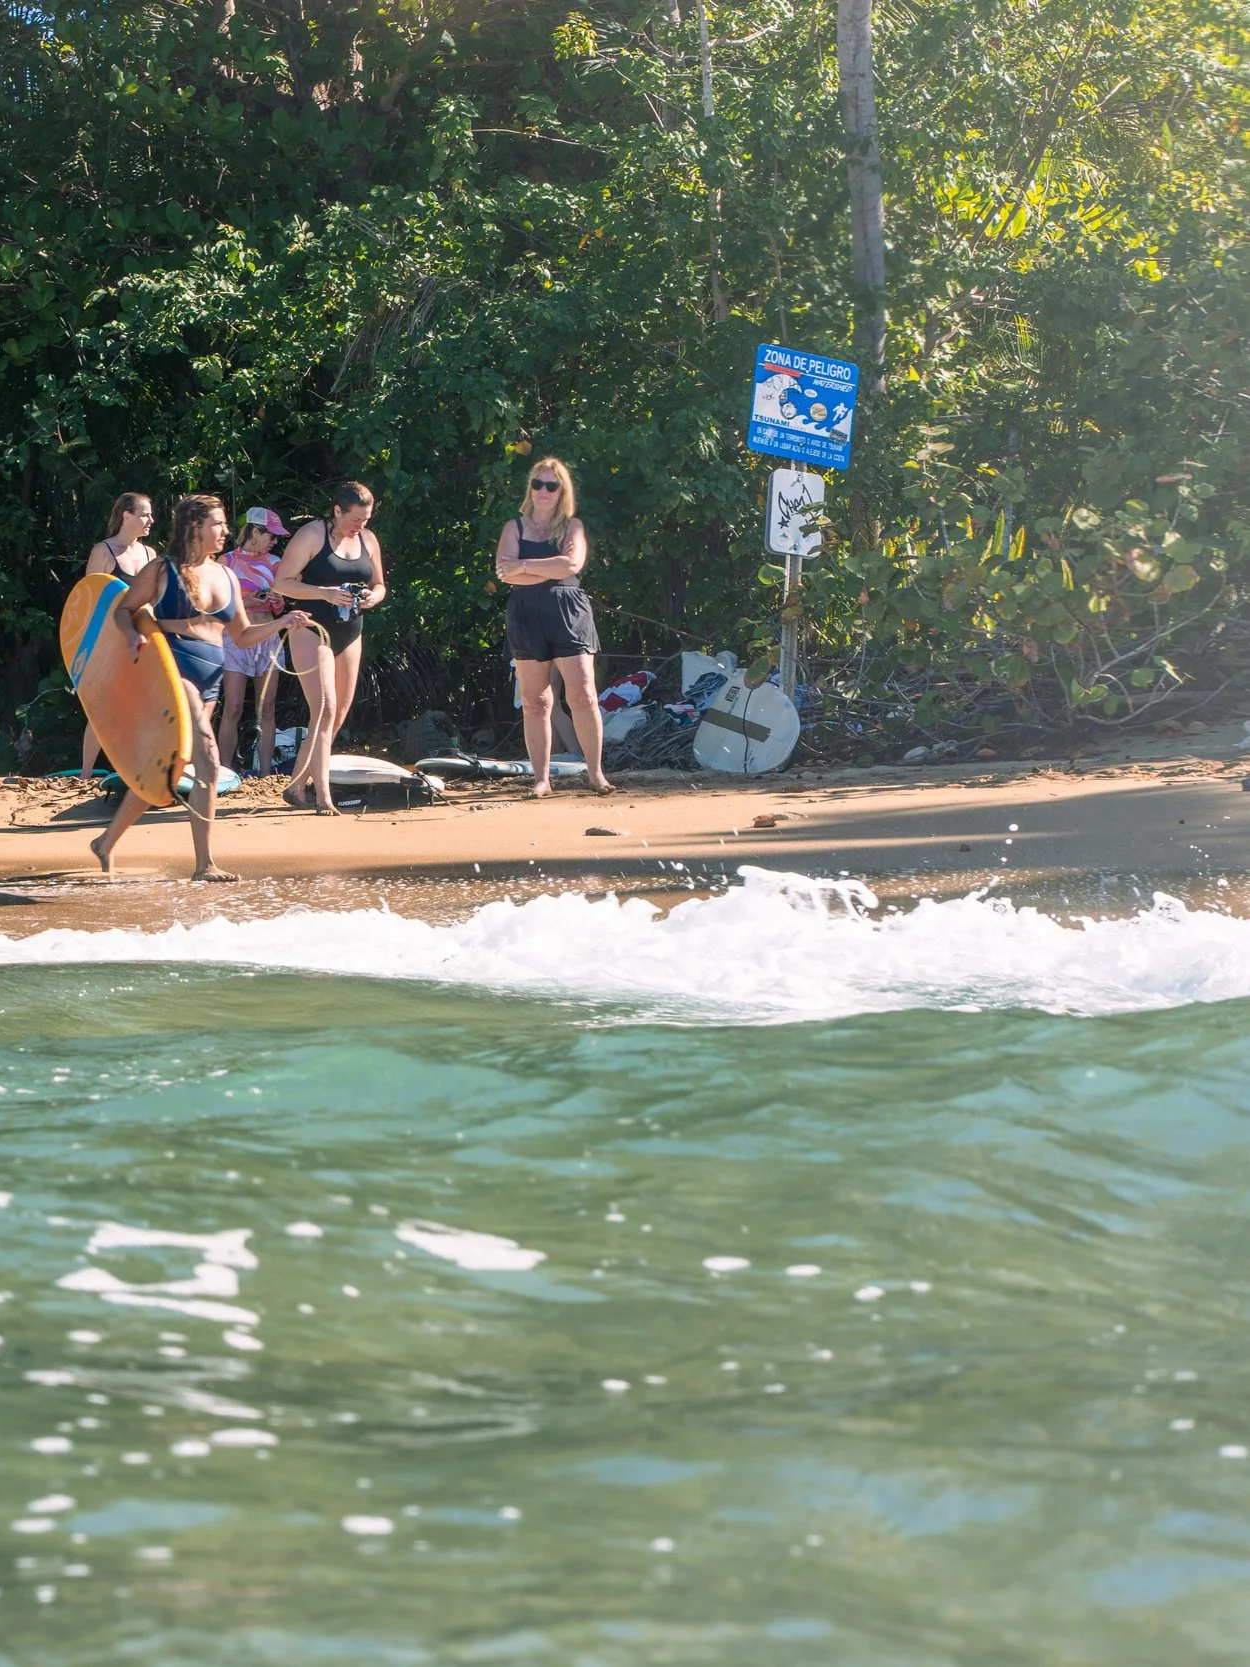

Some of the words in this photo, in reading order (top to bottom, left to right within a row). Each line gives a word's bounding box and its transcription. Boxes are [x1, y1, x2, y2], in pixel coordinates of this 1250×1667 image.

[764, 349, 791, 367] ZONA
[793, 355, 807, 371] DE
[808, 359, 851, 380] PELIGRO
[753, 413, 790, 427] TSUNAMI
